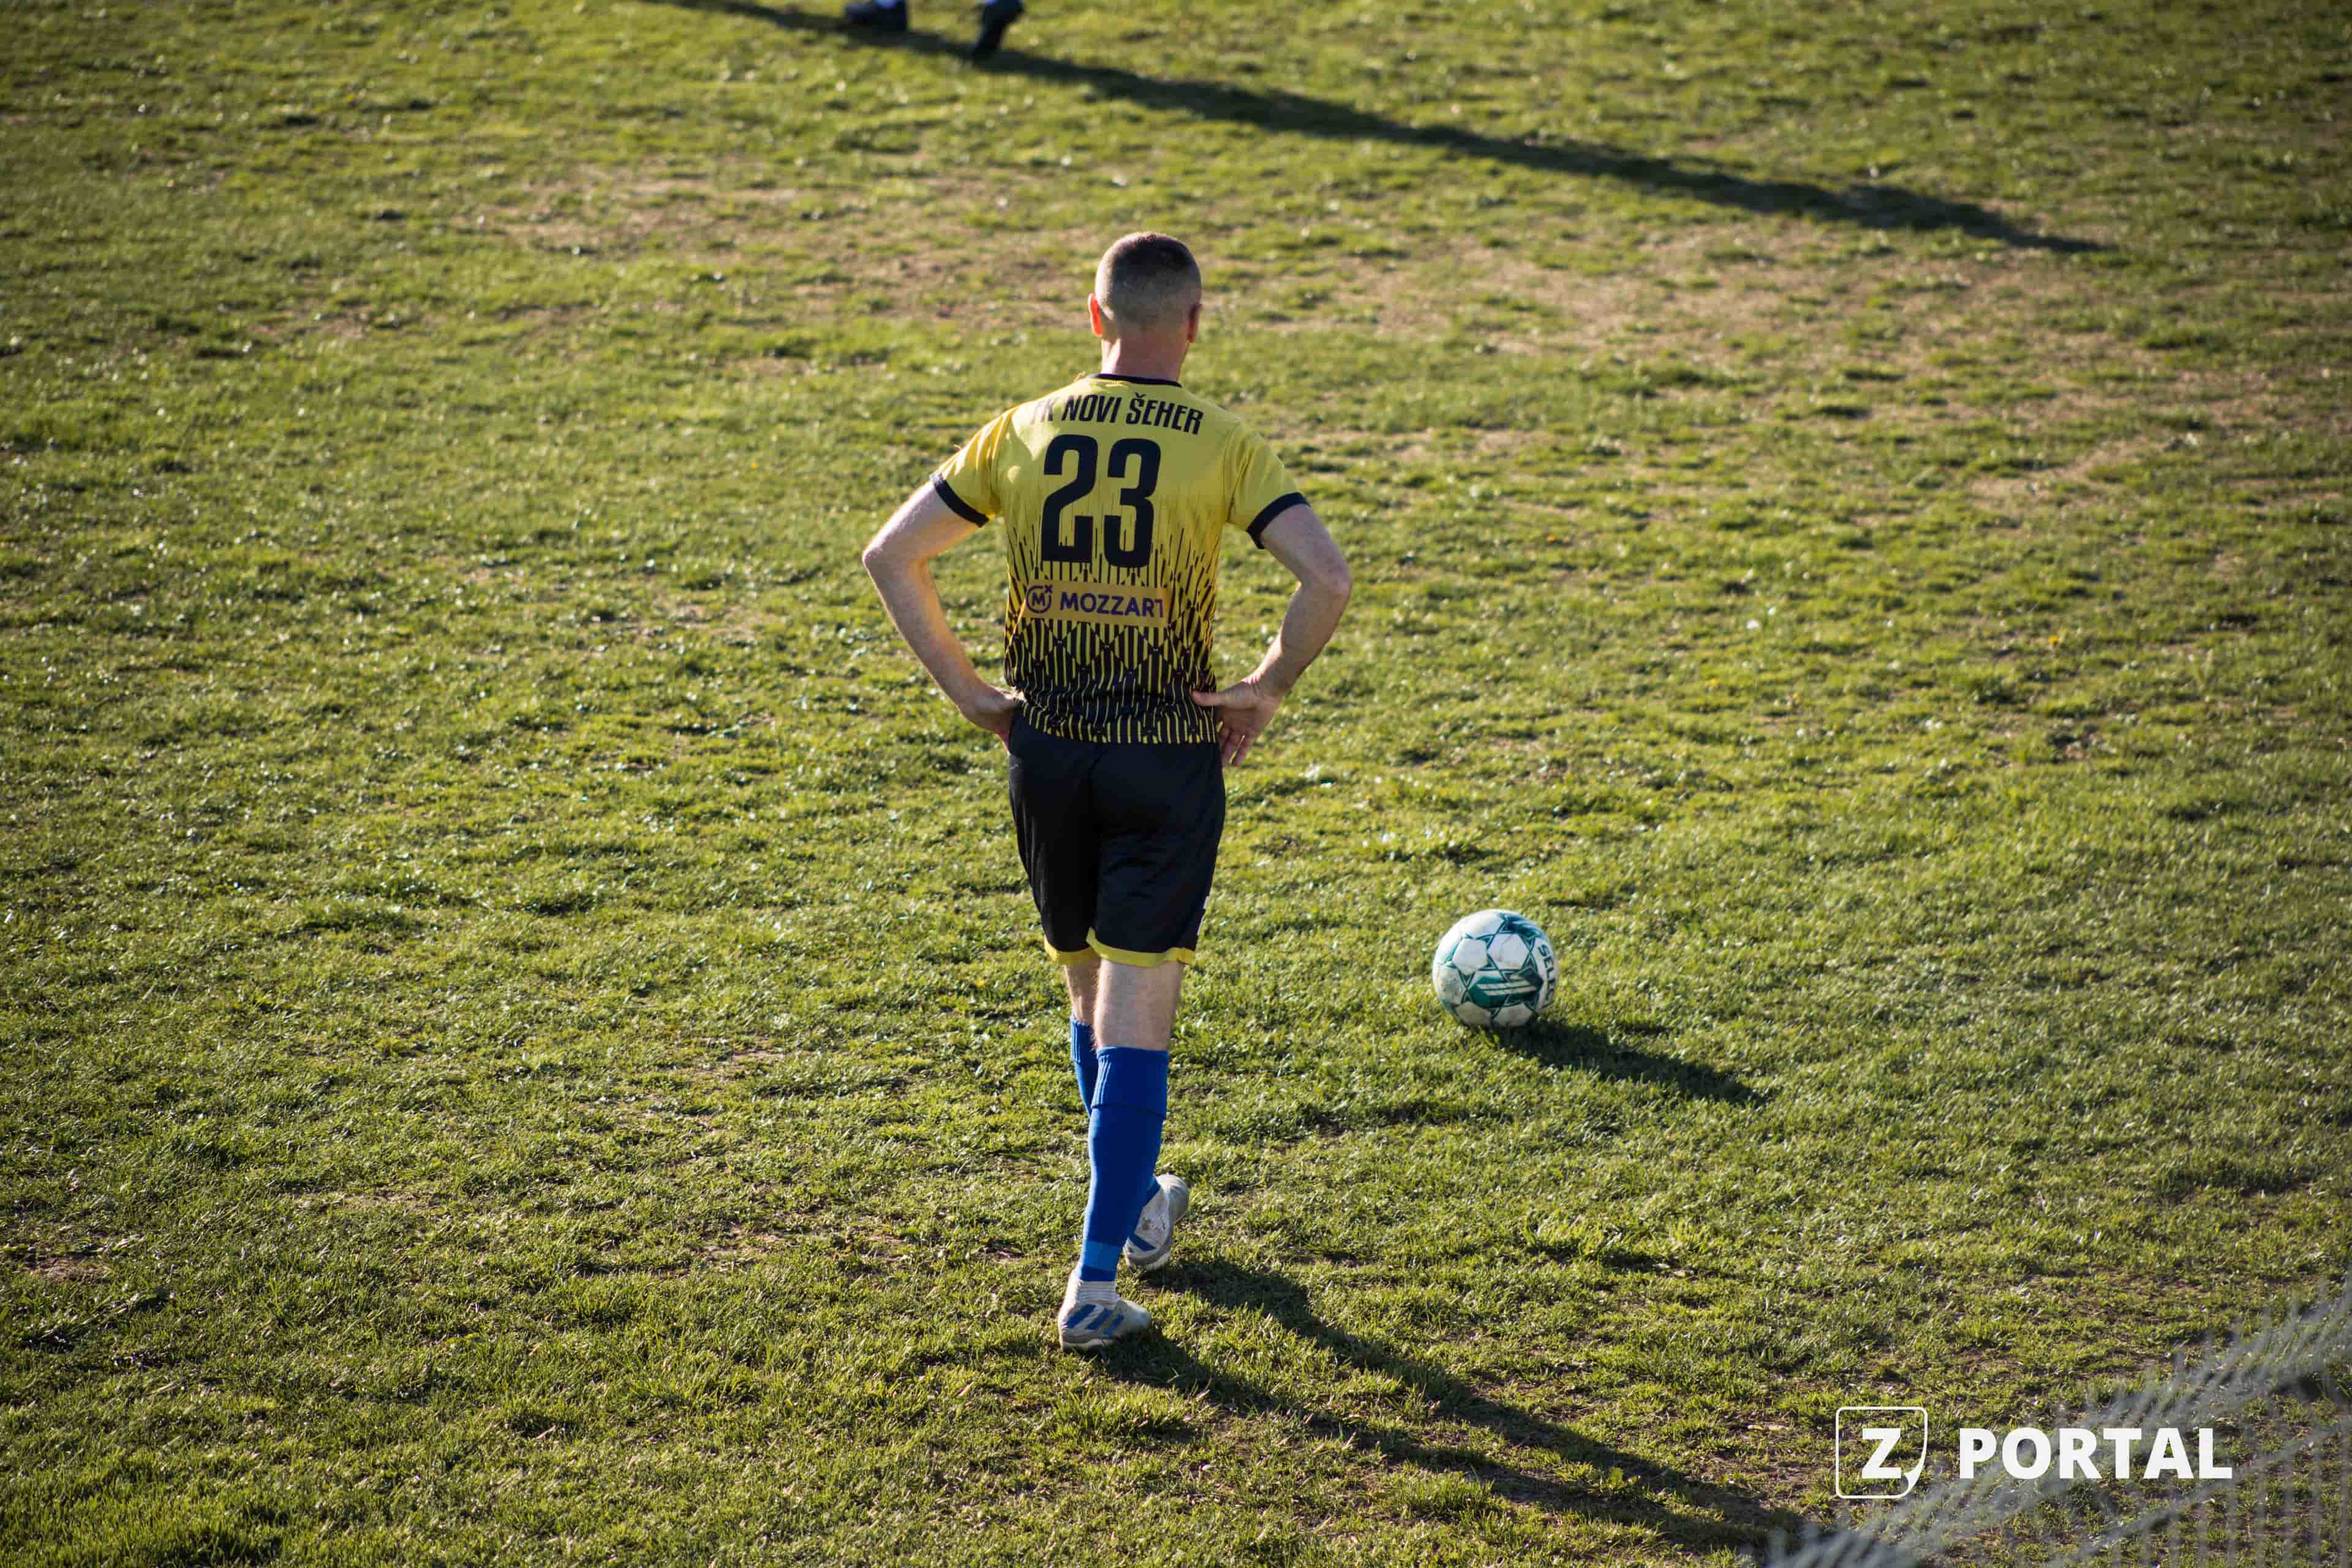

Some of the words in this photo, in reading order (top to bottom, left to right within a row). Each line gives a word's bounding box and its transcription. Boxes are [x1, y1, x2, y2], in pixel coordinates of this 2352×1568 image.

[1061, 395, 1122, 423] NOVI
[1126, 393, 1204, 435] ŠEHER
[1041, 434, 1161, 567] 23
